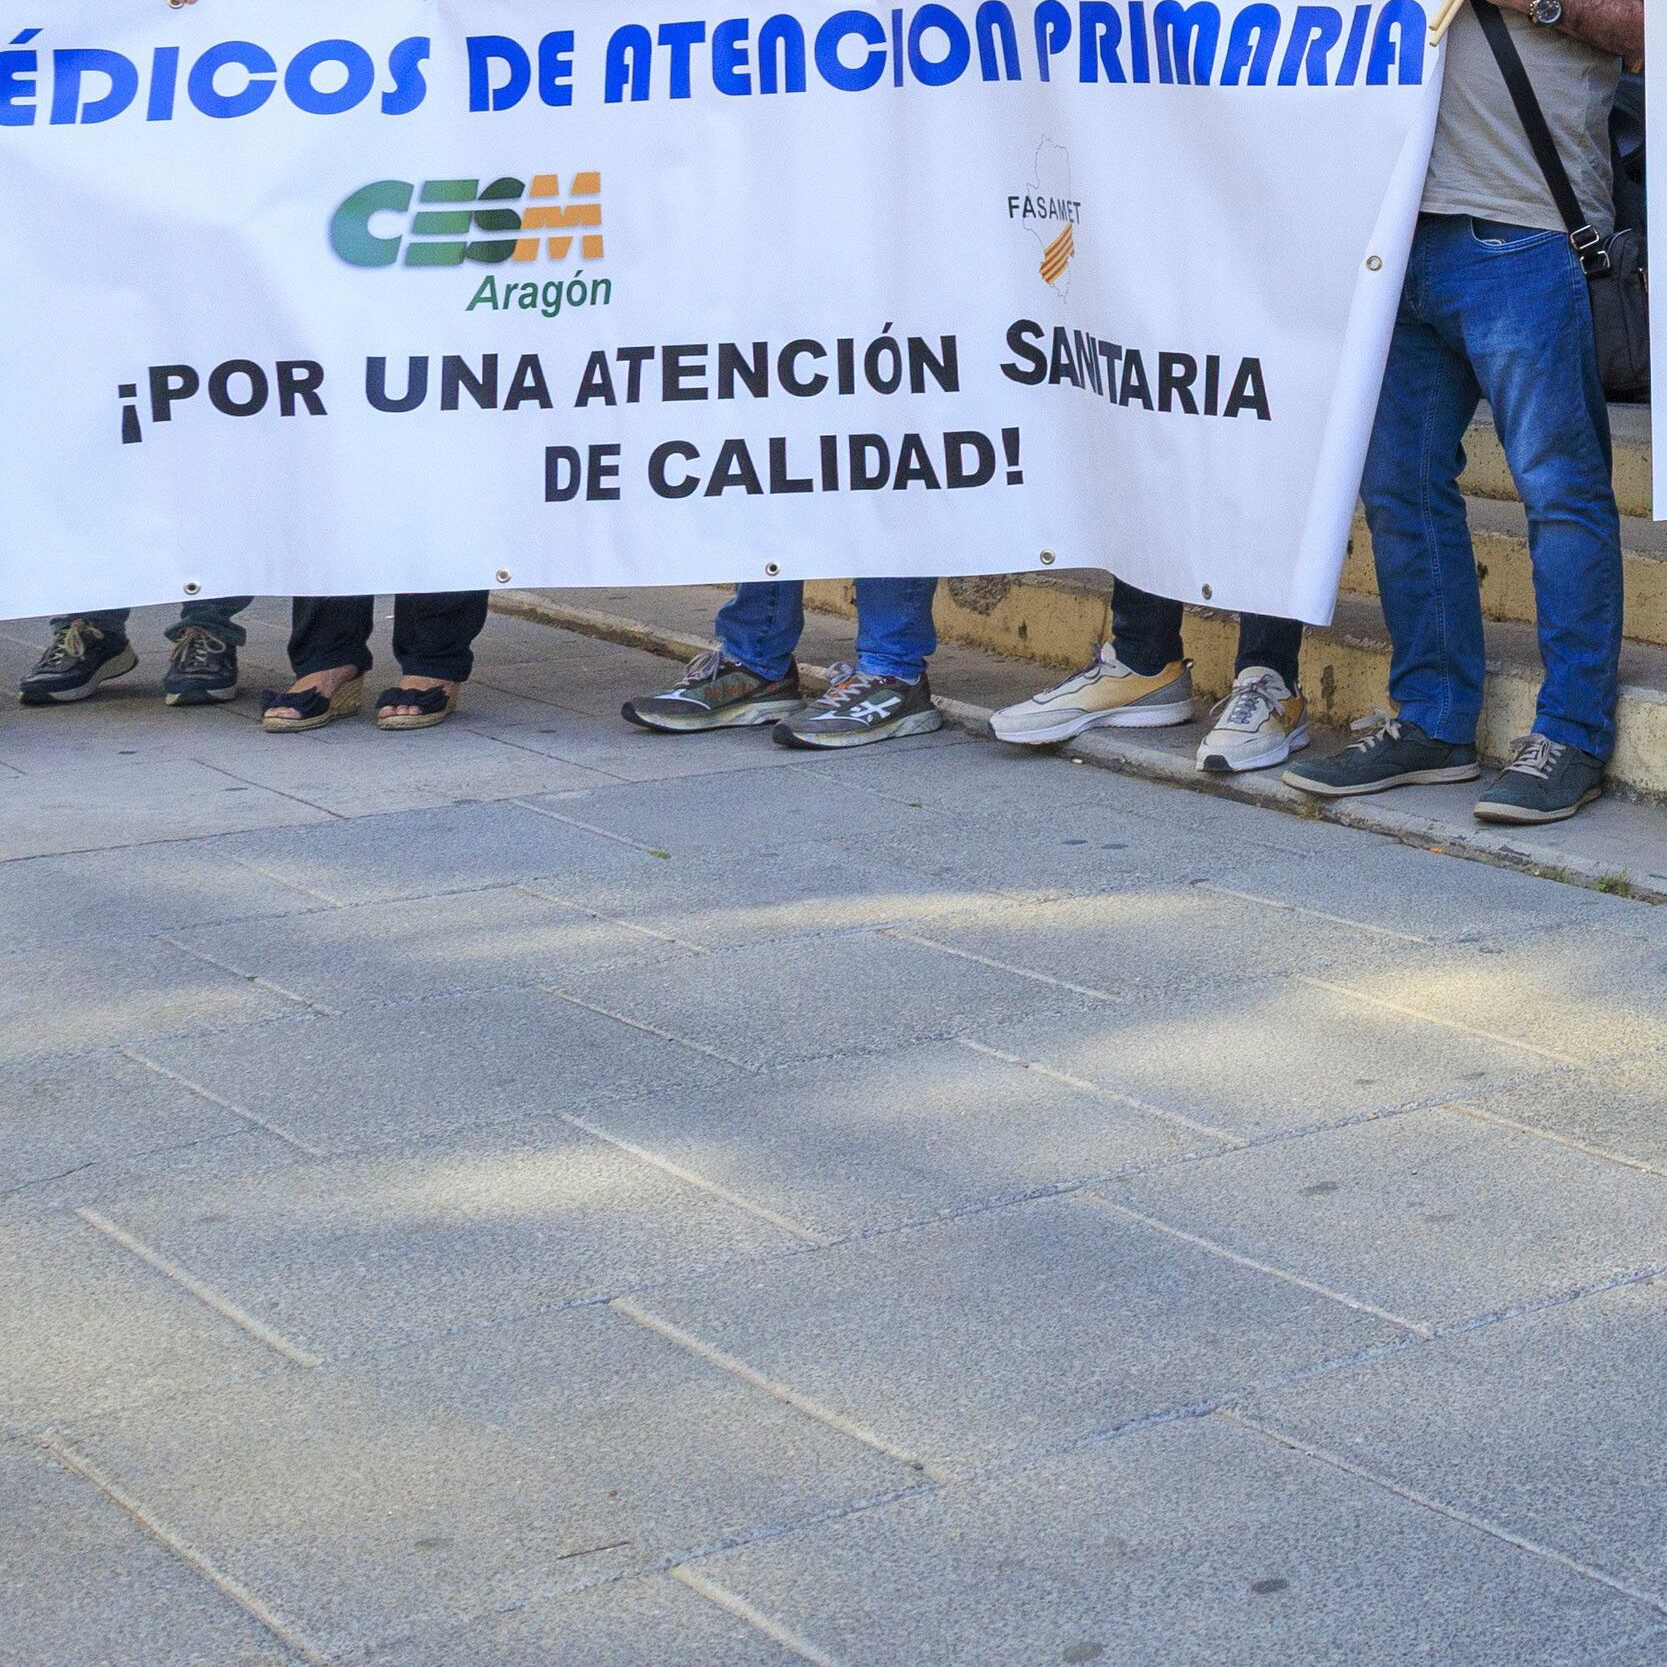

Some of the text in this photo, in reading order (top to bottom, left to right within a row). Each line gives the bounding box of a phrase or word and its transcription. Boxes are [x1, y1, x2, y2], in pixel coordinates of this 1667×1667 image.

[466, 30, 574, 111] DE
[327, 171, 604, 268] CESM
[1007, 195, 1081, 224] FASAMET
[465, 270, 613, 318] Aragón
[117, 317, 1272, 446] ¡POR UNA ATENCIÓN SANITARIA
[545, 426, 1026, 504] DE CALIDAD!
